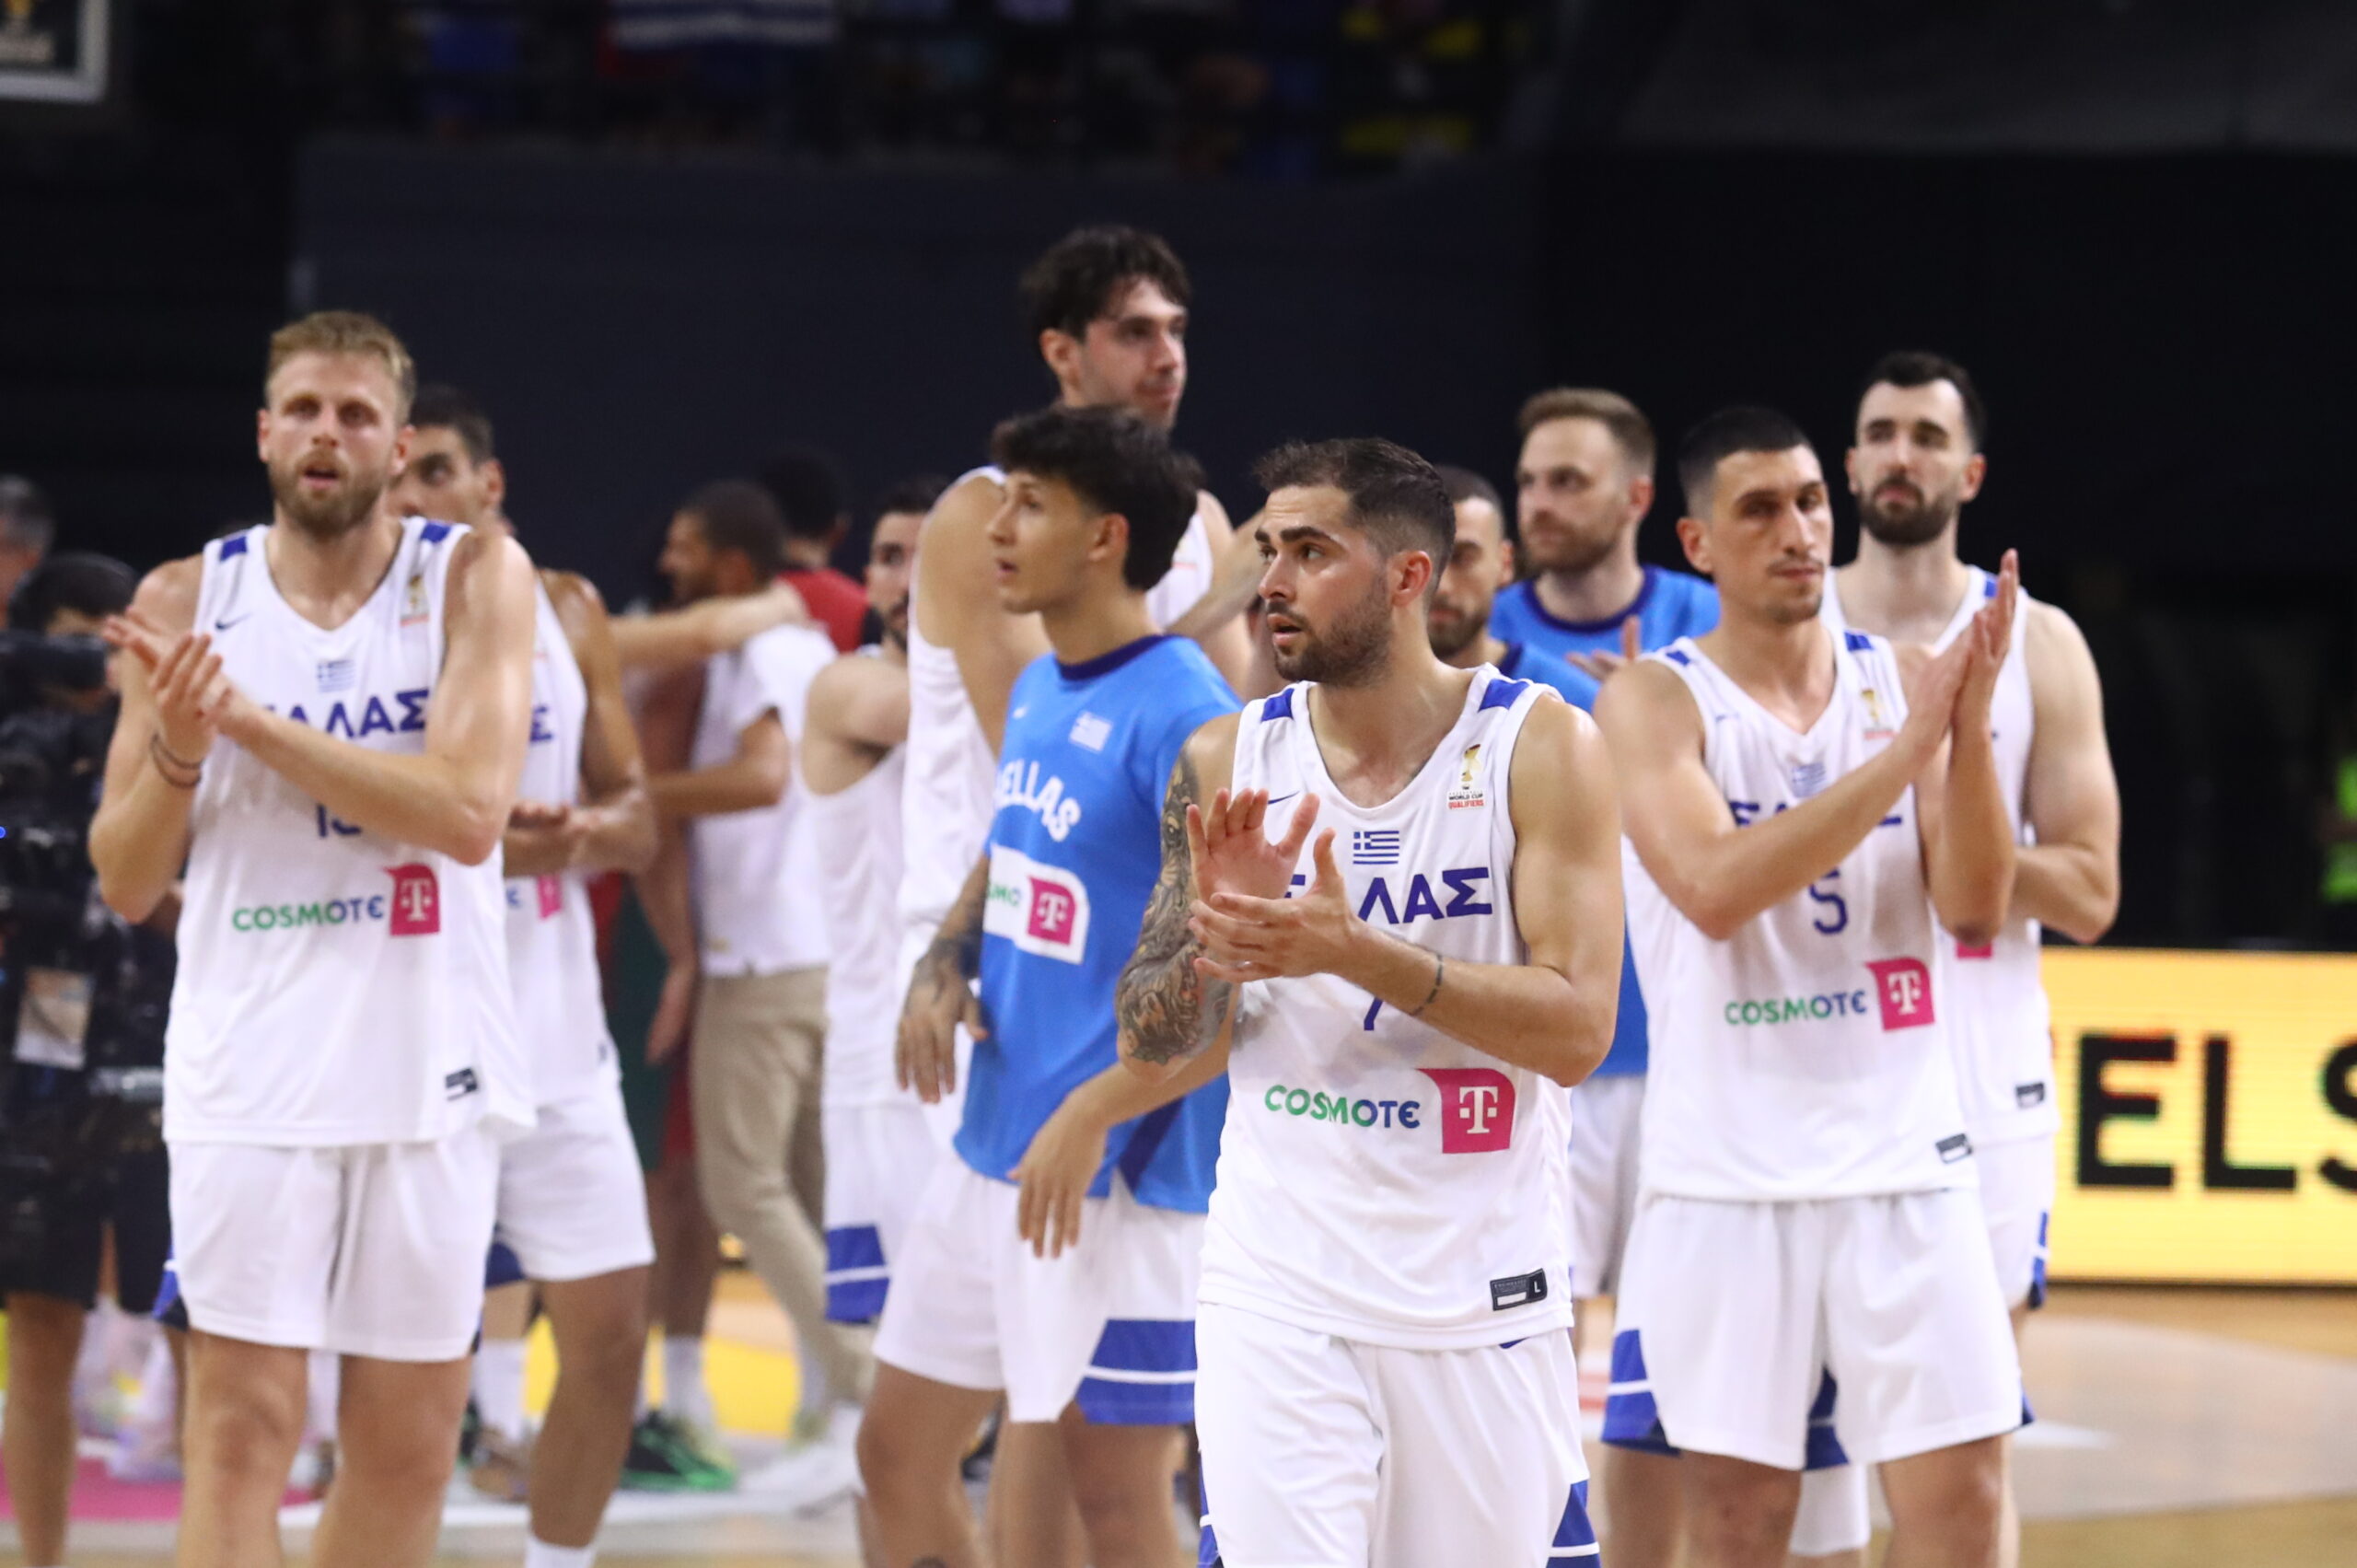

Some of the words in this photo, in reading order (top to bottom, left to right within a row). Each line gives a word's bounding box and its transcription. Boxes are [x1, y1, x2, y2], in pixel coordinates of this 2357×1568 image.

[232, 895, 385, 931] COSMOTE
[400, 877, 434, 922] T
[1808, 867, 1849, 935] 5
[1724, 990, 1867, 1025] COSMOTE
[1888, 970, 1922, 1016] T
[1264, 1085, 1421, 1129] COSMOTE
[1459, 1086, 1499, 1134] T
